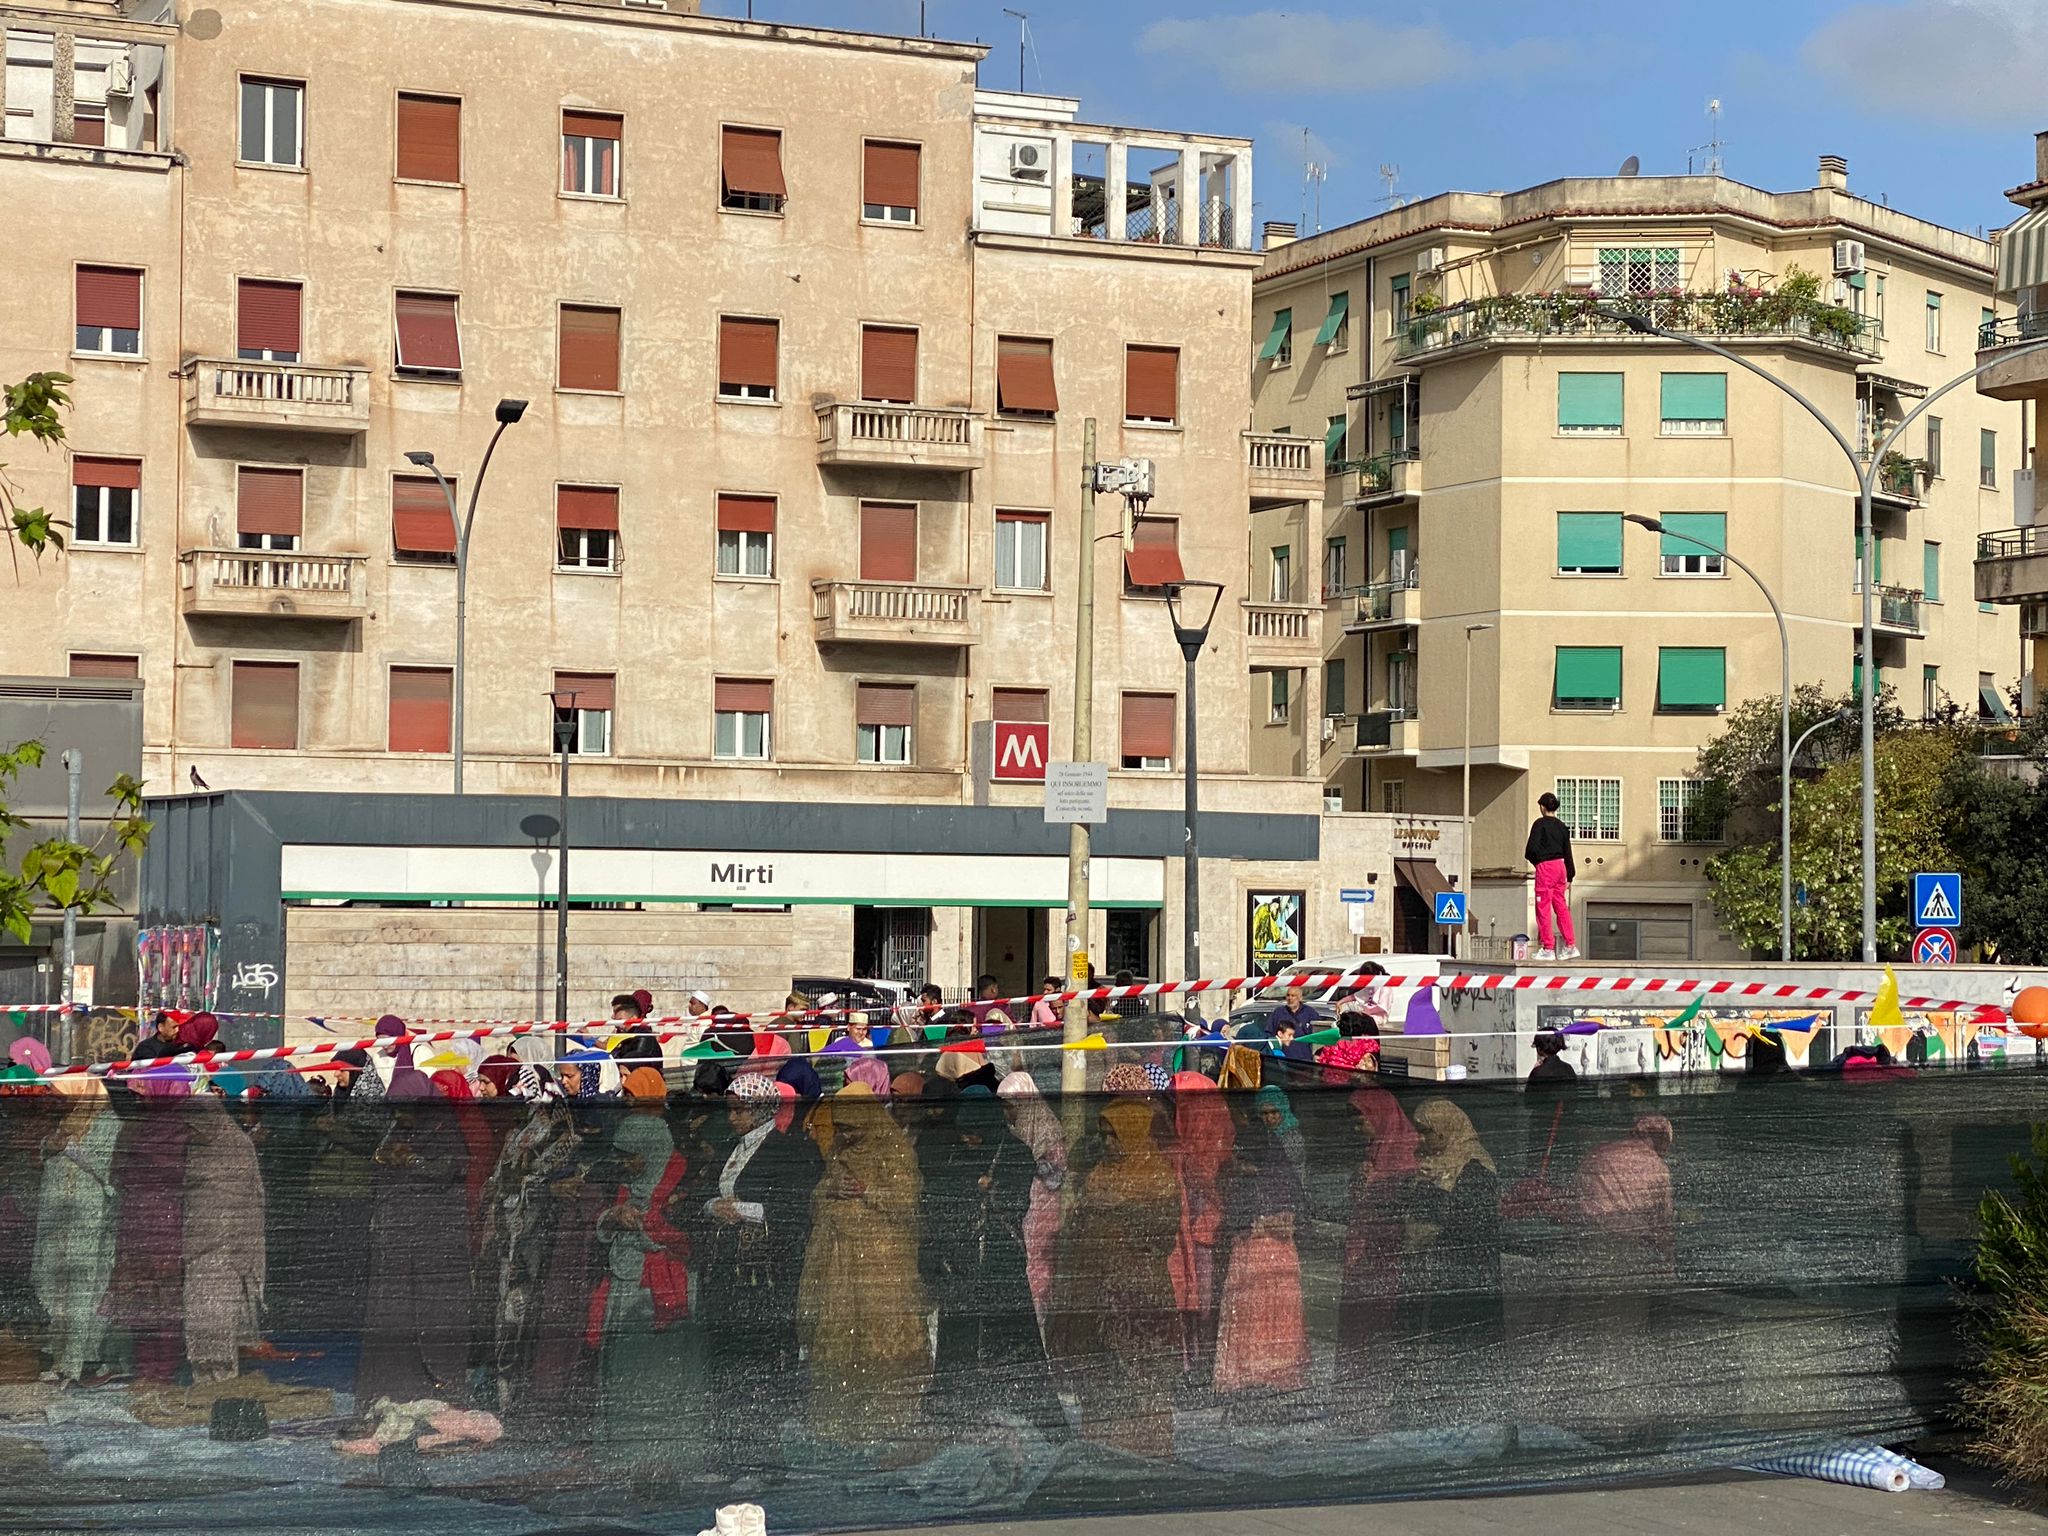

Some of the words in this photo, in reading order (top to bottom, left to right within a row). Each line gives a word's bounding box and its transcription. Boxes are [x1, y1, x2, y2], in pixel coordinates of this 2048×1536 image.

[1000, 733, 1043, 768] M
[1050, 780, 1061, 788] QUI
[711, 863, 773, 884] Mirti
